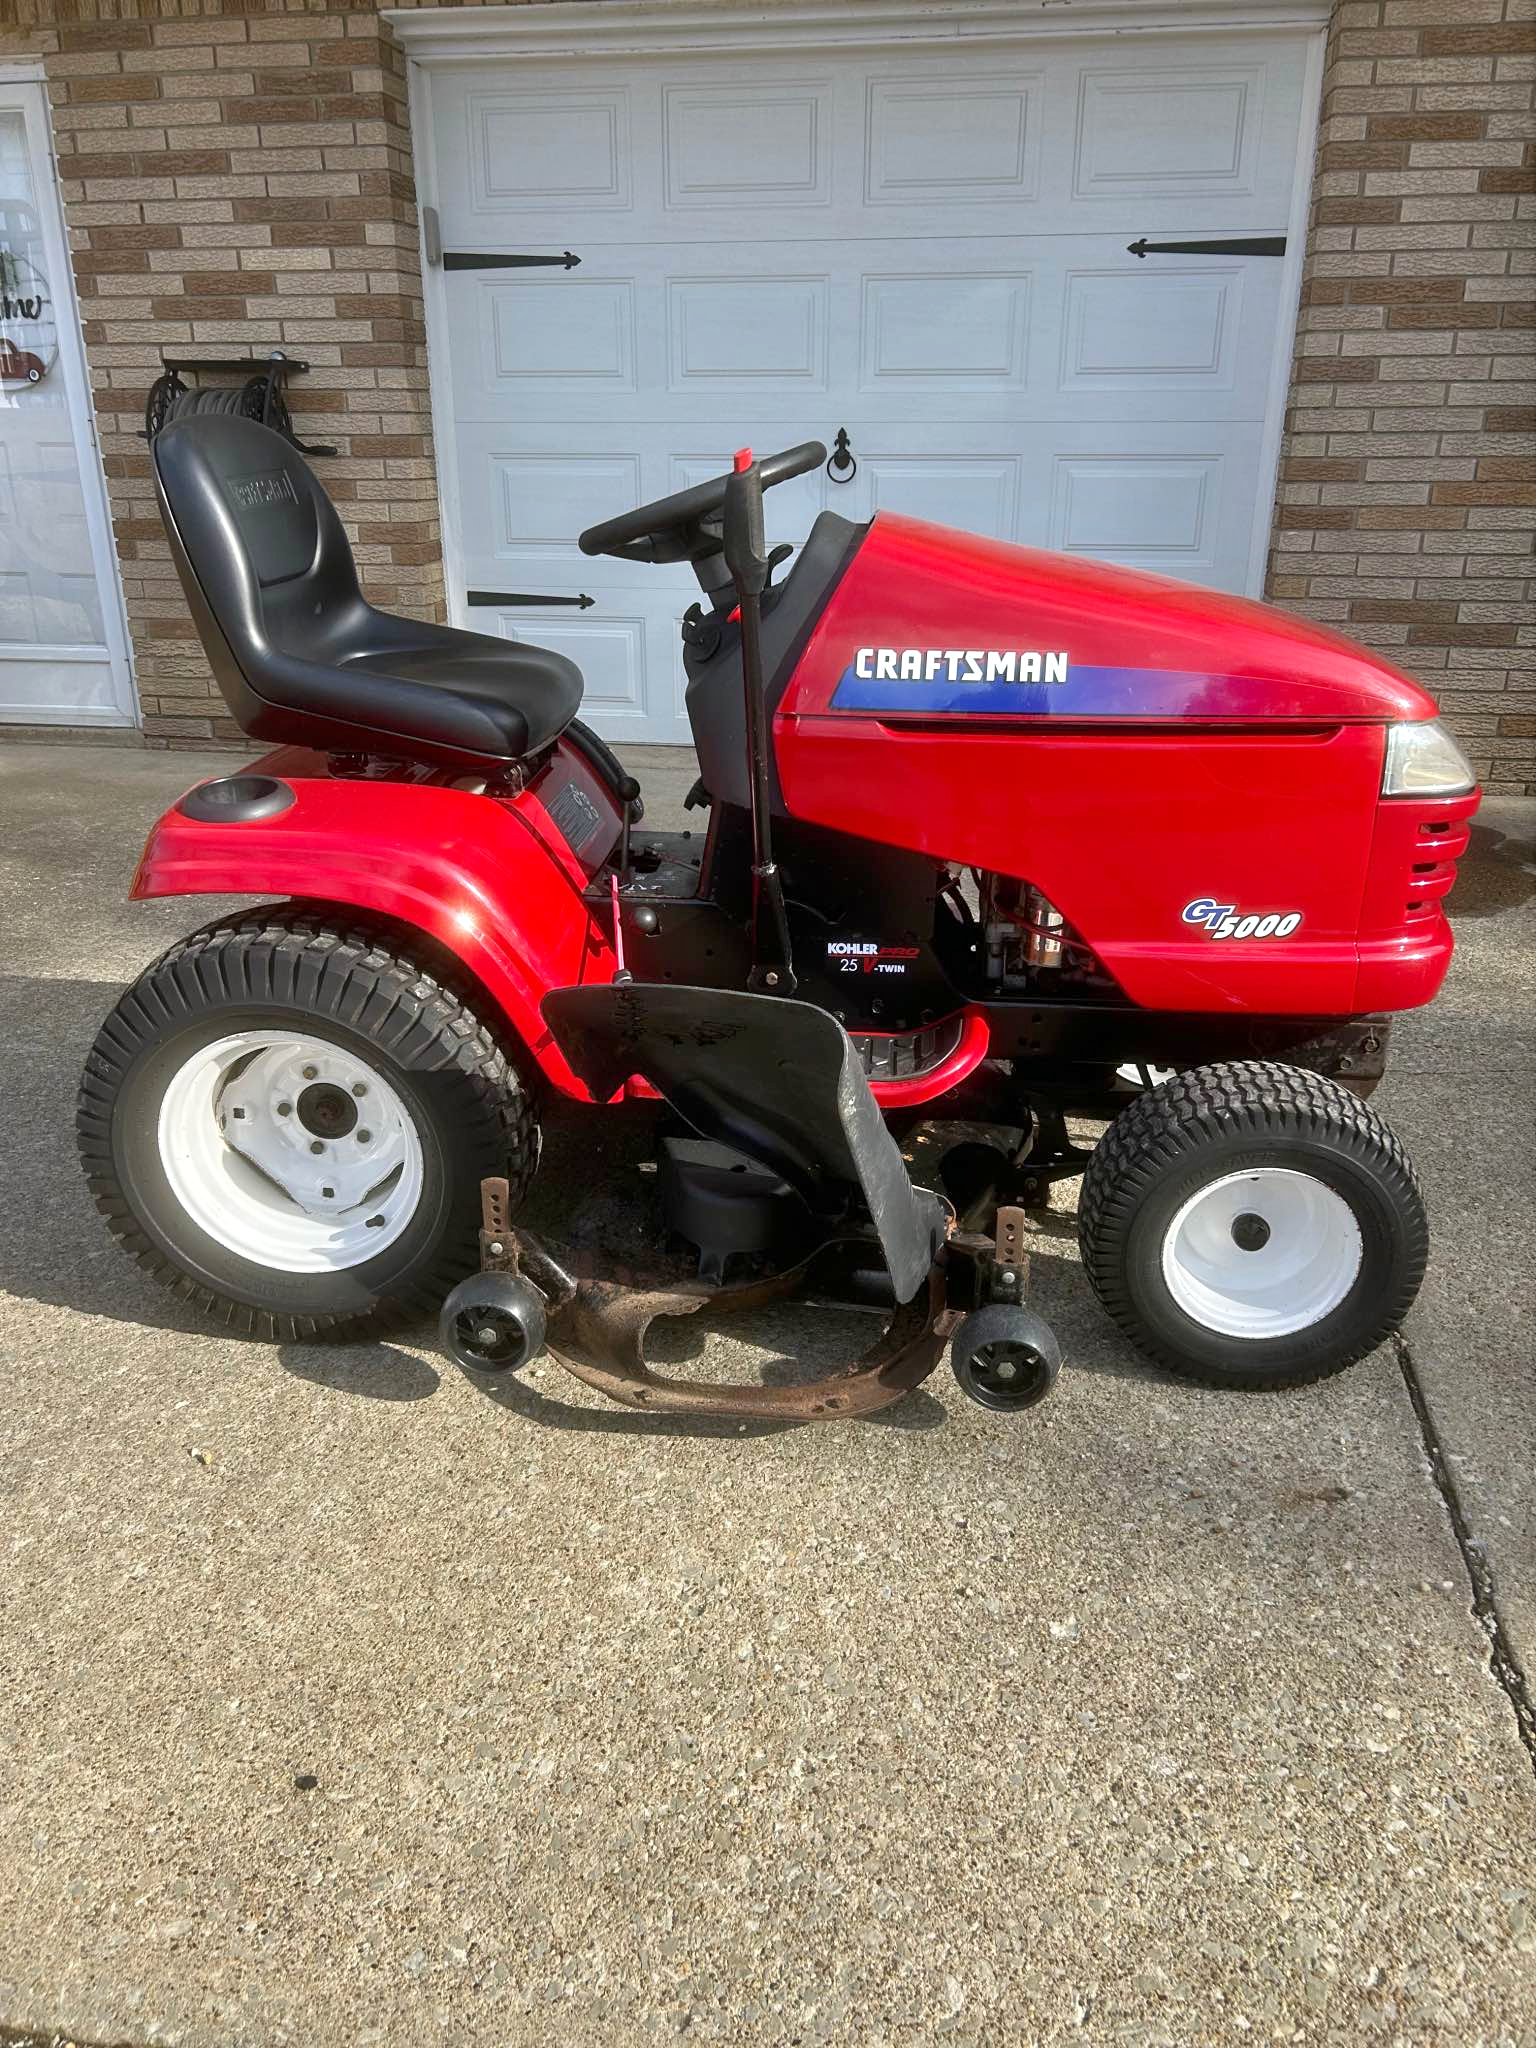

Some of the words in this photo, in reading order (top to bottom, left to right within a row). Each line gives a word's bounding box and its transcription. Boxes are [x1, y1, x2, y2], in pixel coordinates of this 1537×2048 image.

[855, 648, 1068, 682] CRAFTSMAN
[827, 943, 878, 955] KOHLER
[840, 958, 858, 972] 25
